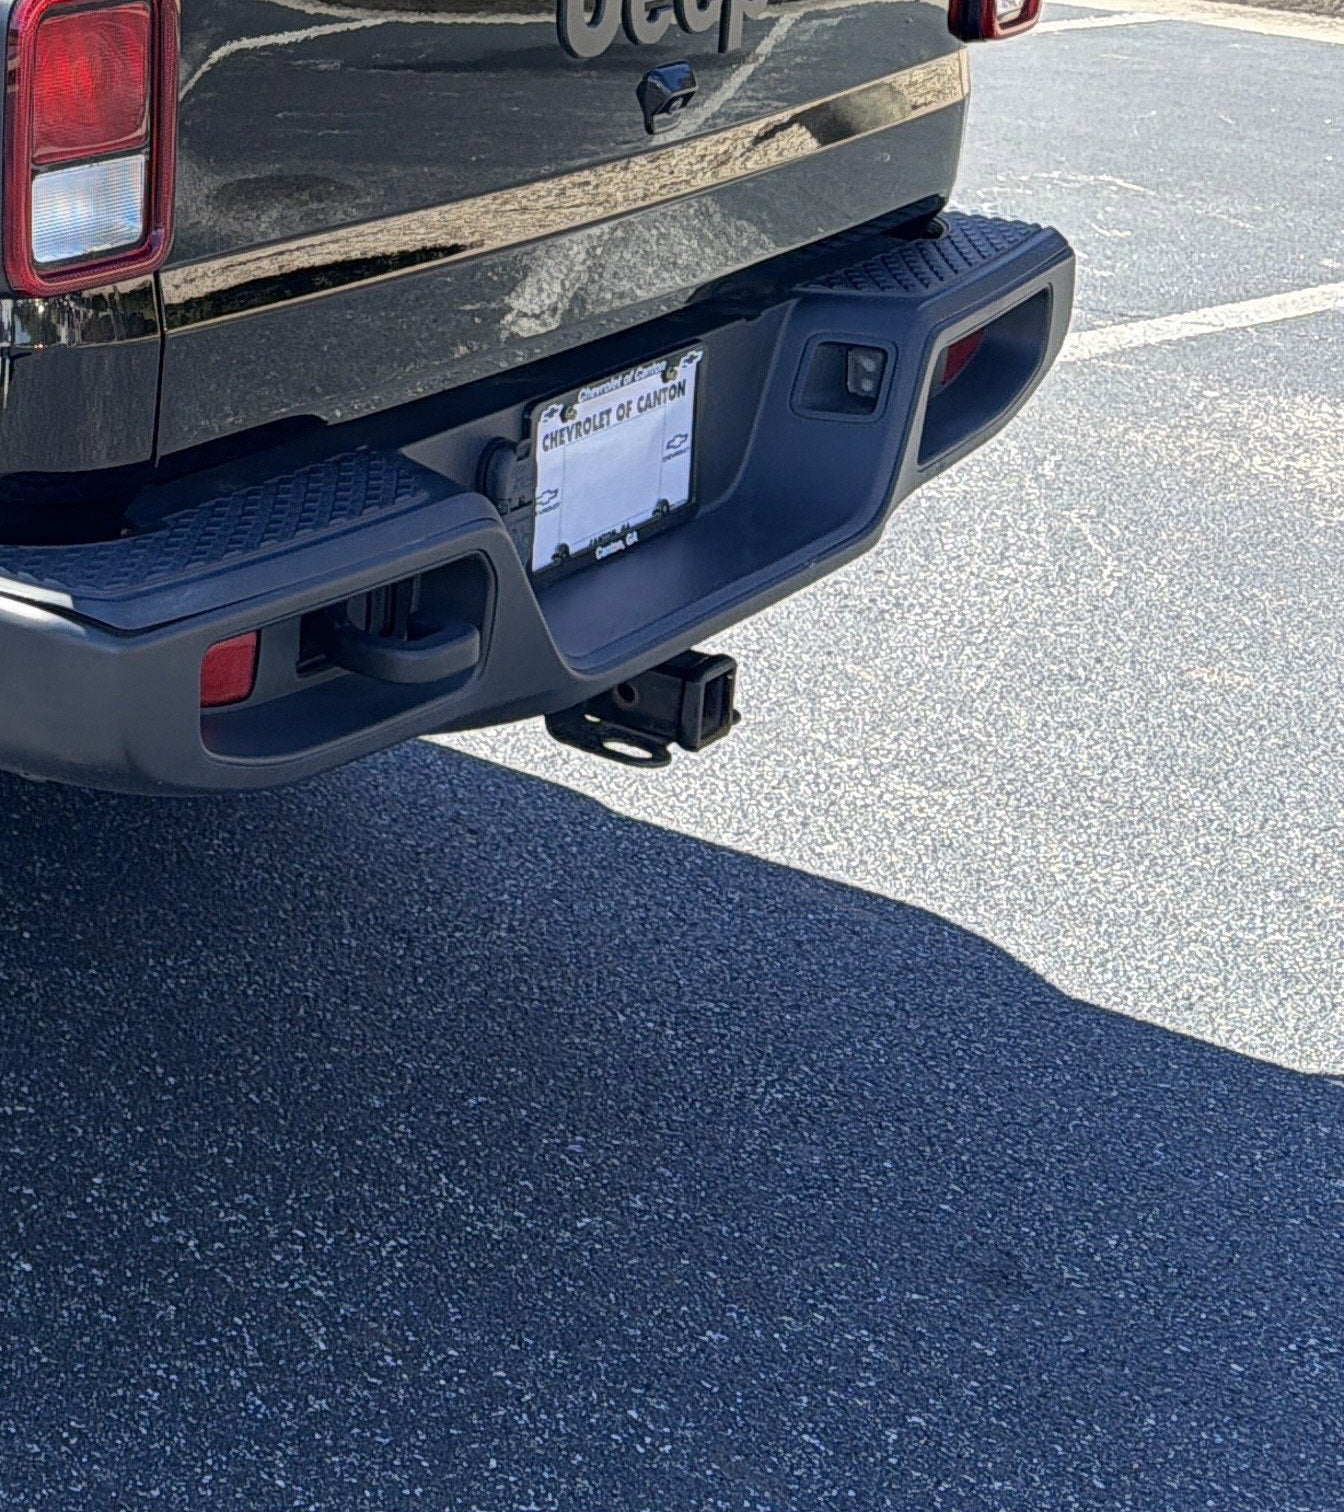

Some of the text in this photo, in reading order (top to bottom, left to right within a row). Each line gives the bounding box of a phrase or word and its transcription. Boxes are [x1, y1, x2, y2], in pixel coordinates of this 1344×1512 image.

[542, 378, 687, 453] CHEVROLET OF CANTON
